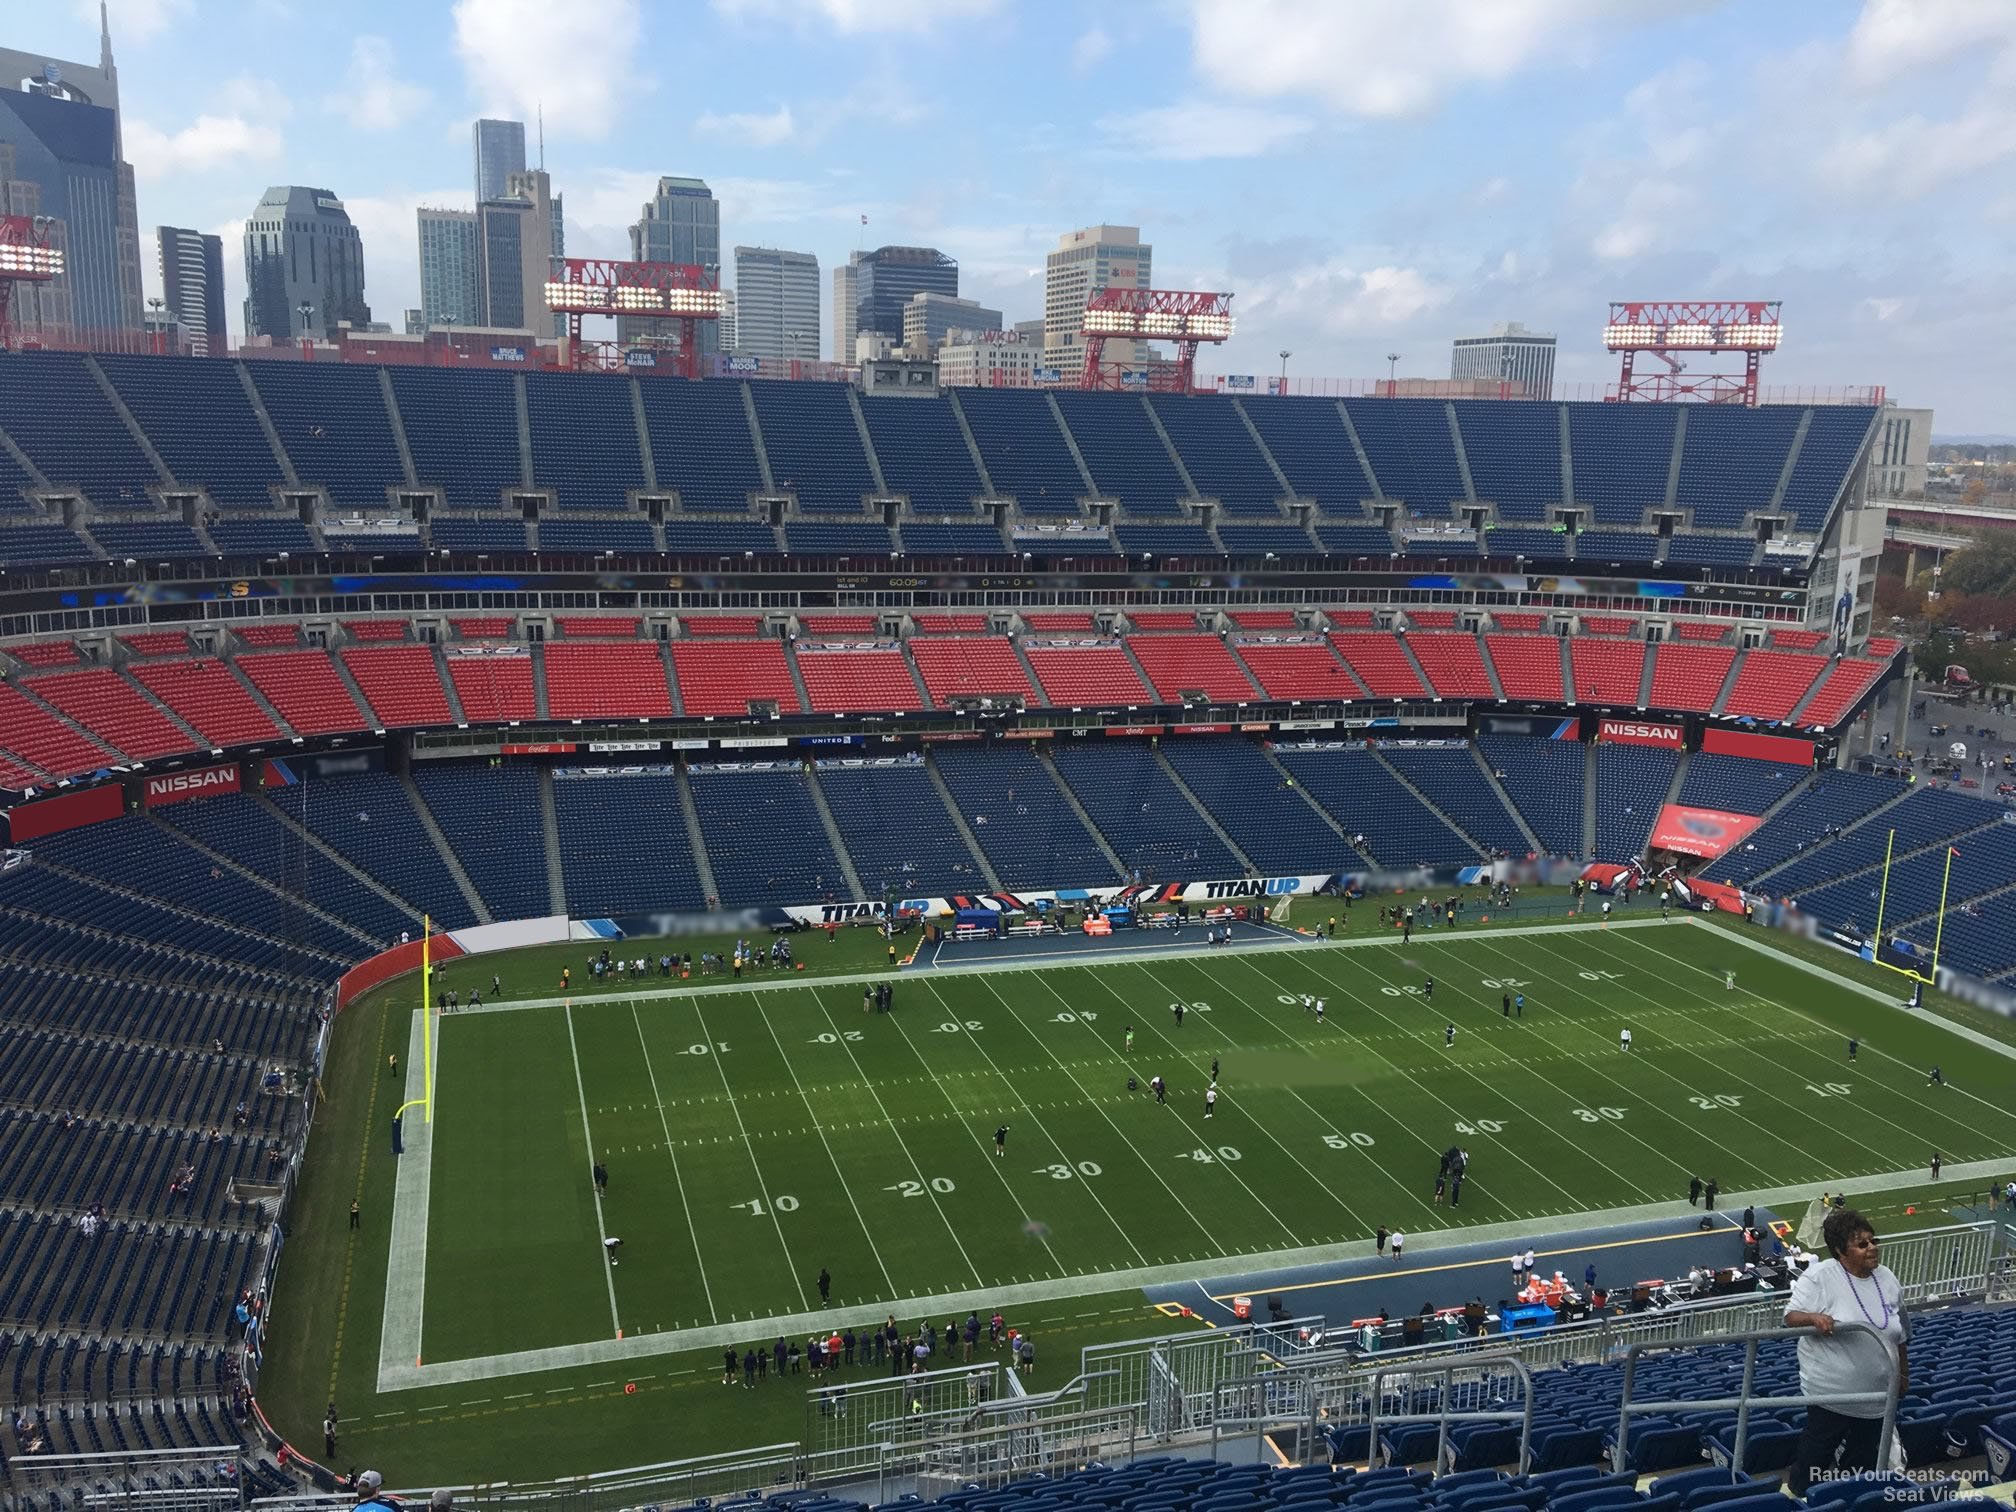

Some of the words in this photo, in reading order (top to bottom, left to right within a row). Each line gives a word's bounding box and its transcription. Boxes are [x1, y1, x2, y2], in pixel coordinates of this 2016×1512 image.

[492, 353, 525, 361] MATTHEWS
[1073, 729, 1087, 737] CMT
[1126, 728, 1145, 736] xfinity
[1604, 723, 1678, 740] NISSAN
[150, 768, 235, 796] NISSAN
[1660, 835, 1720, 849] NISSAN
[1667, 843, 1702, 856] NISSAN
[1057, 1010, 1098, 1023] 40
[940, 1020, 985, 1033] 30
[817, 1030, 865, 1044] 20
[688, 1041, 733, 1056] 10
[1805, 1083, 1851, 1097] 10
[1689, 1094, 1741, 1110] 20
[1572, 1107, 1624, 1123] 30
[1454, 1119, 1503, 1136] 40
[1322, 1132, 1376, 1149] 50
[1192, 1146, 1242, 1164] 40
[1047, 1161, 1102, 1180] 30
[898, 1177, 956, 1198] 20
[746, 1195, 800, 1216] 10
[1238, 1306, 1246, 1315] G
